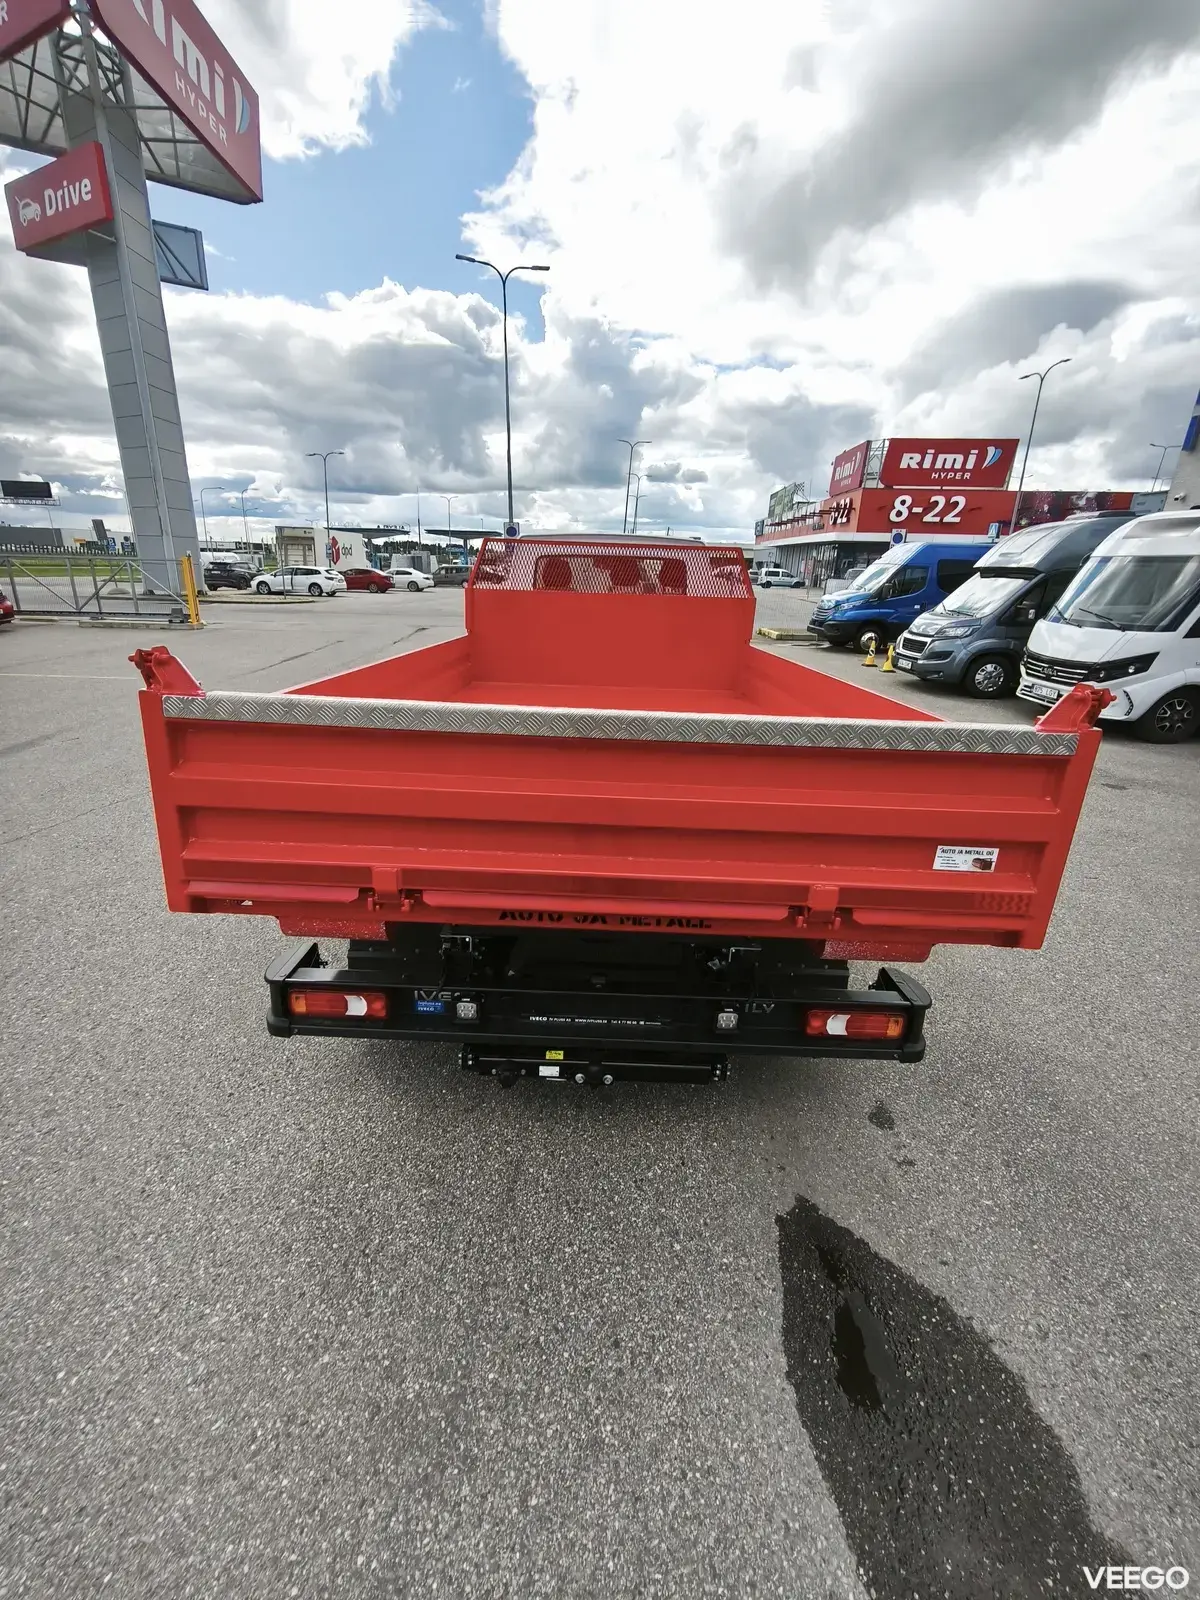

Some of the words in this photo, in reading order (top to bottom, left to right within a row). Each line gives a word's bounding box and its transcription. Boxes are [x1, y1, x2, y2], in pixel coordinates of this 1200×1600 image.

[132, 0, 226, 120] imi
[174, 71, 228, 147] HYPER
[44, 177, 92, 217] Drive
[834, 456, 856, 481] Rimi
[899, 449, 979, 470] Rimi
[931, 472, 972, 480] HYPER
[889, 495, 967, 523] 8-22
[341, 542, 353, 559] dpd
